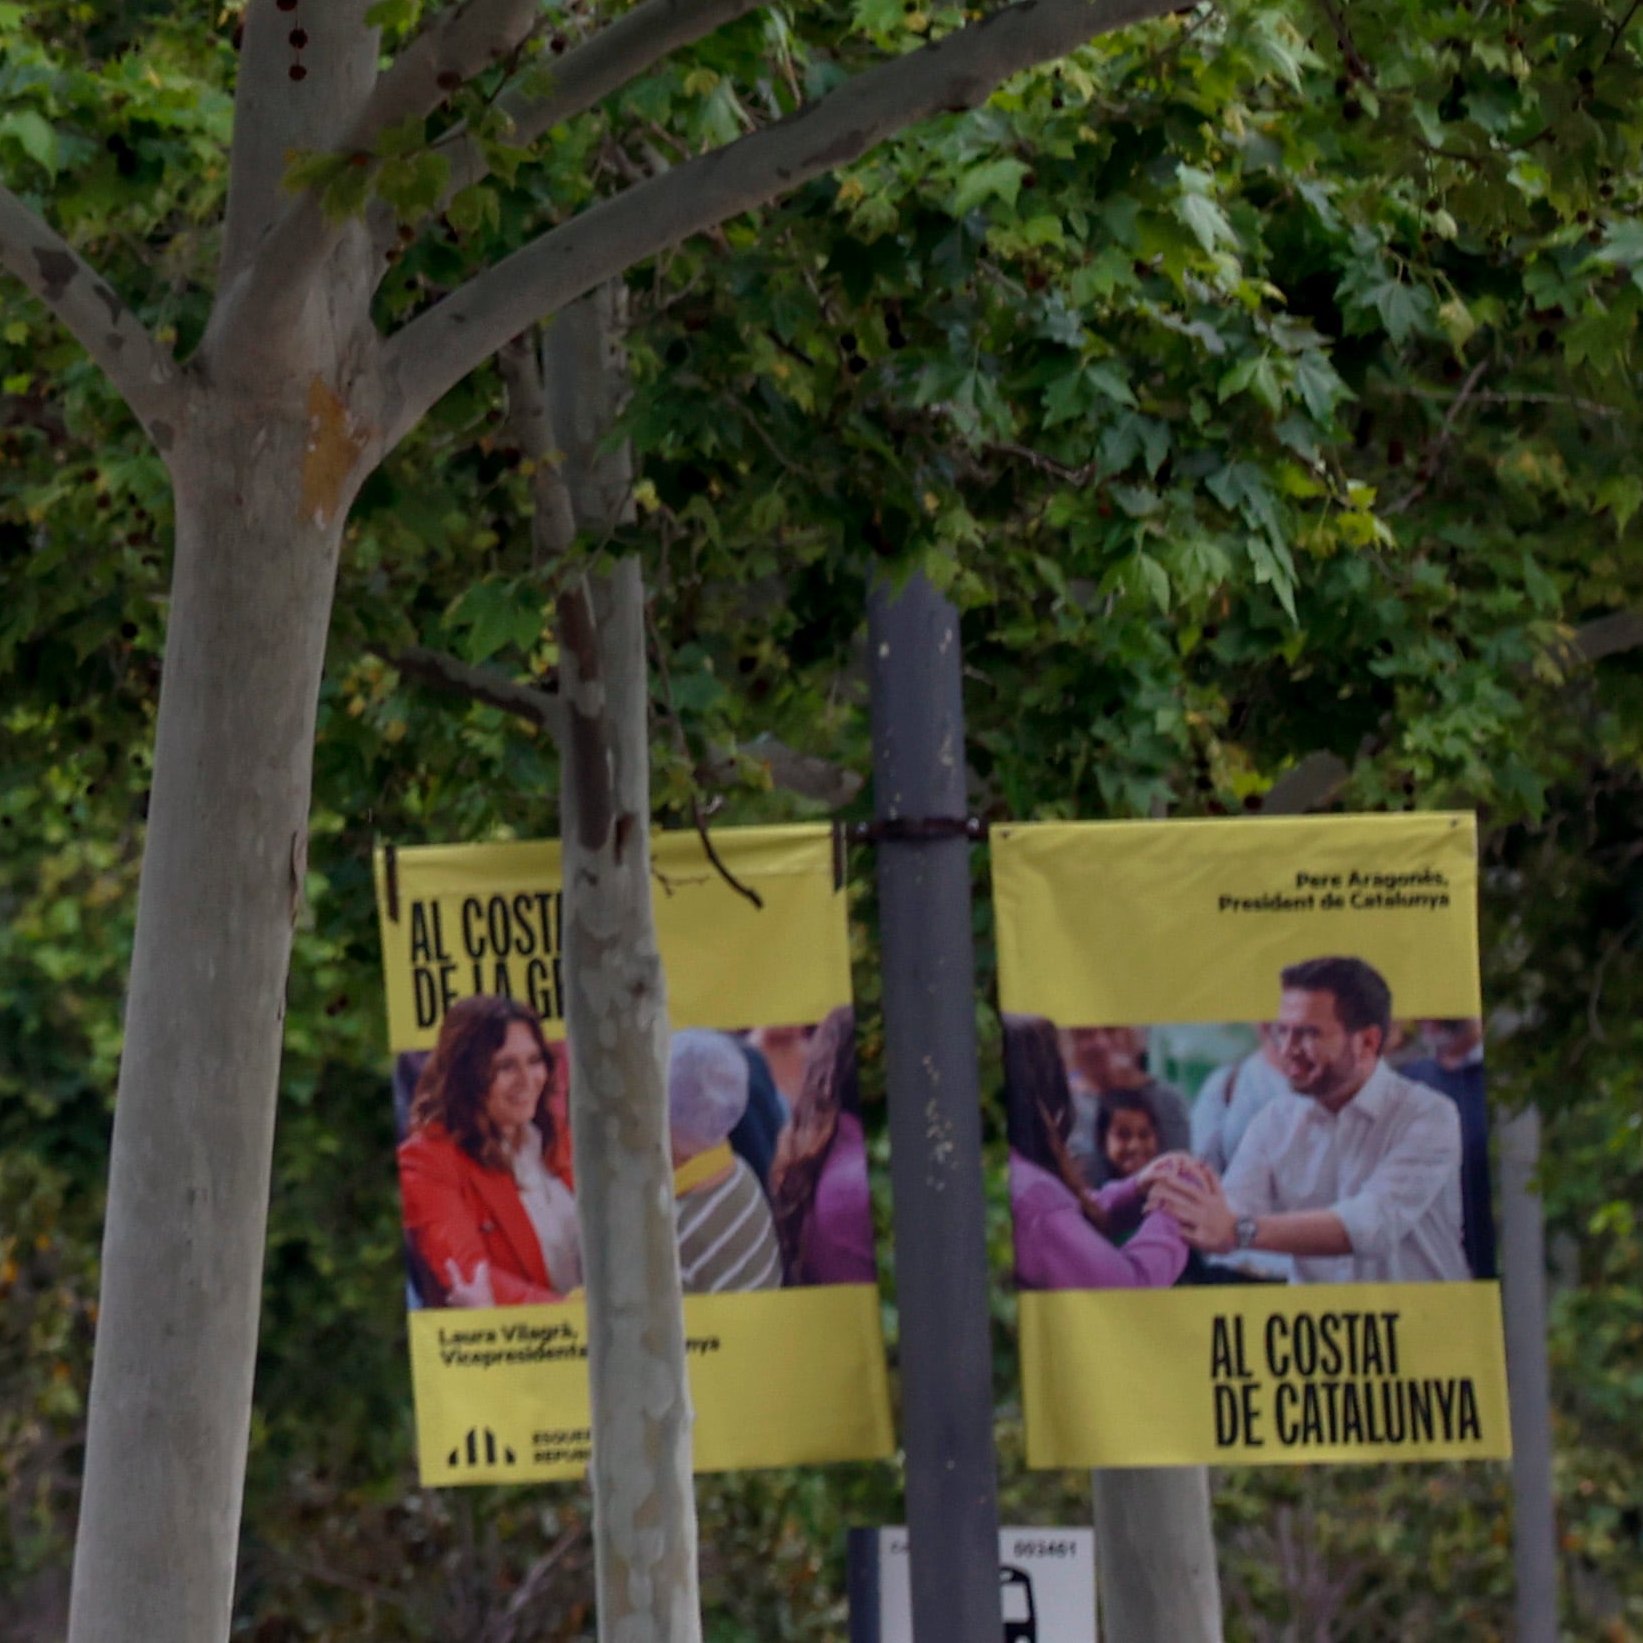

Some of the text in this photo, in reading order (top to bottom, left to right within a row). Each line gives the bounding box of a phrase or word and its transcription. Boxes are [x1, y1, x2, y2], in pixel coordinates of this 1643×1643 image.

[412, 890, 562, 962] AL COST
[1321, 894, 1344, 908] de
[414, 965, 456, 1028] DE
[1211, 1313, 1400, 1378] AL COSTAT
[1215, 1377, 1482, 1448] DE CATALUNYA
